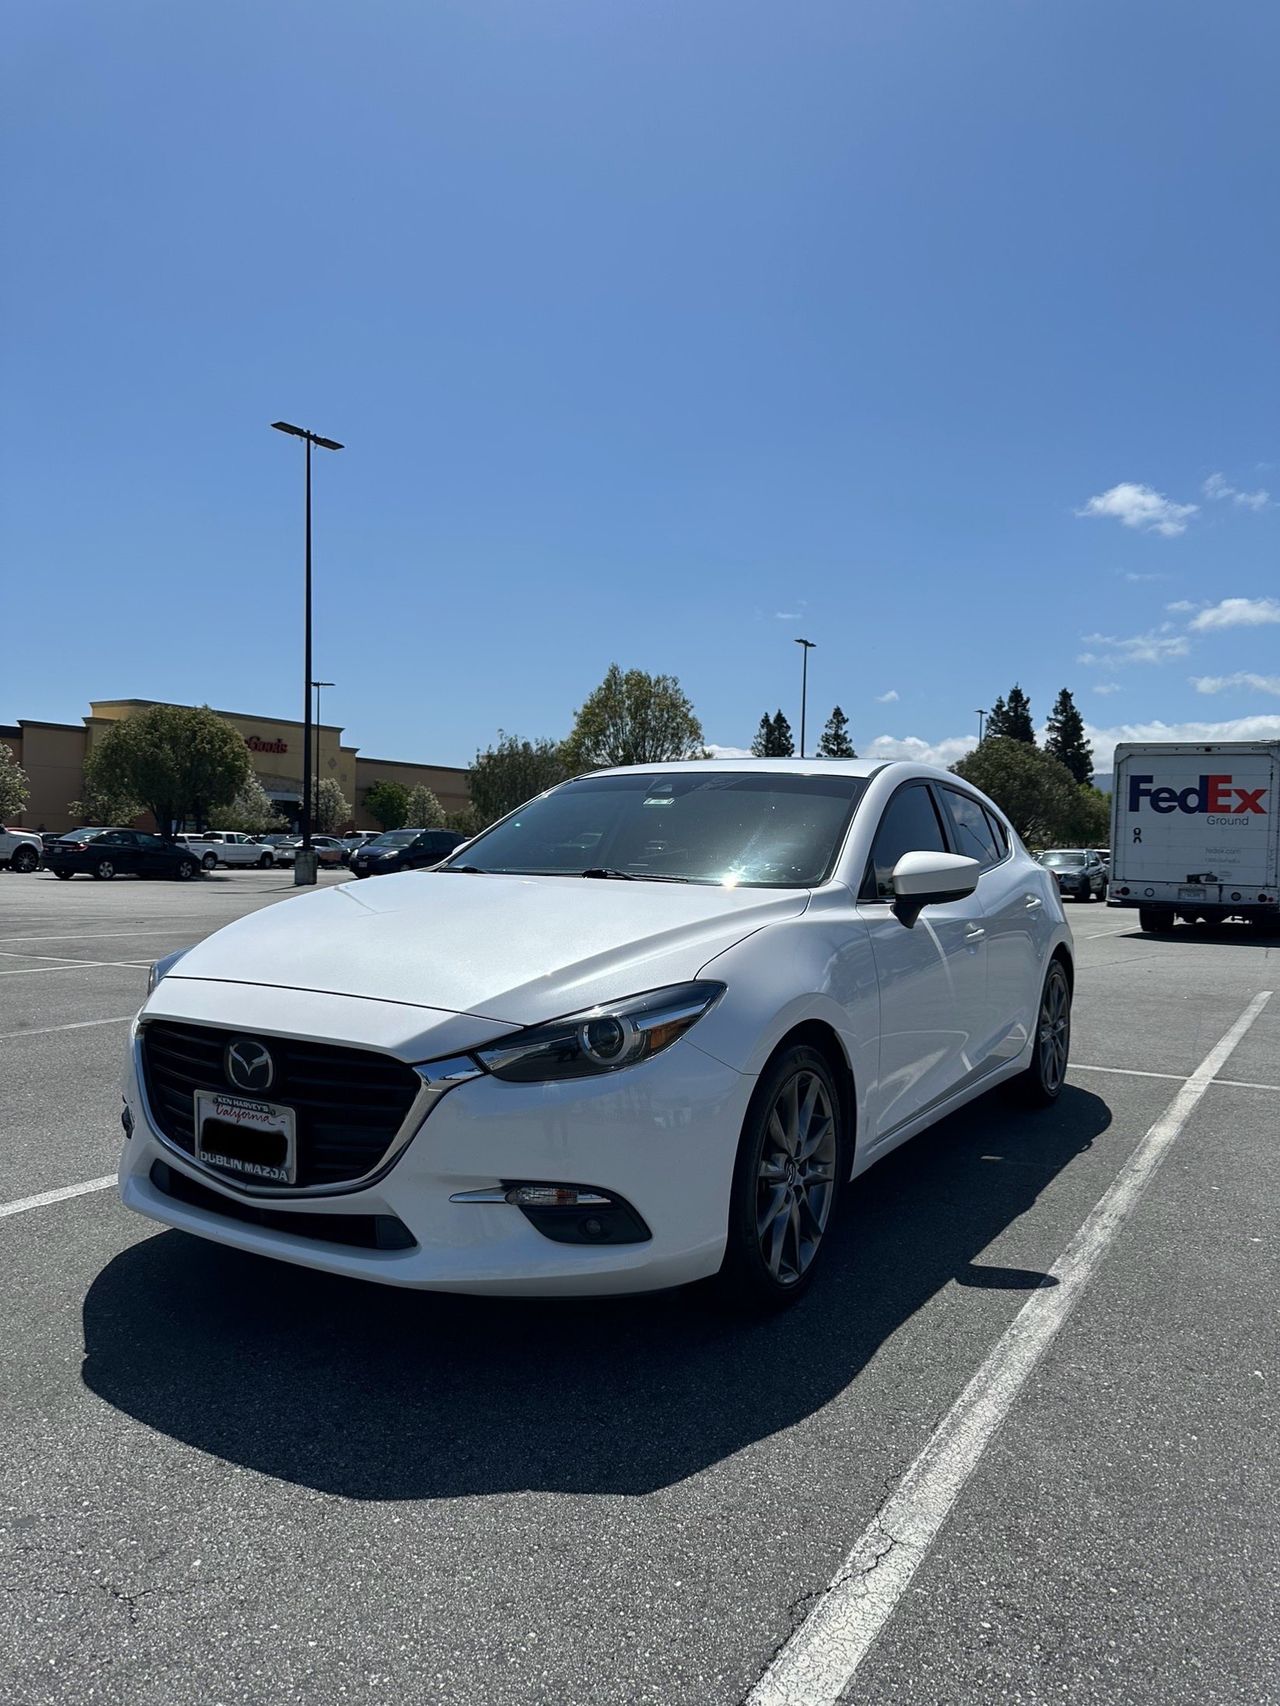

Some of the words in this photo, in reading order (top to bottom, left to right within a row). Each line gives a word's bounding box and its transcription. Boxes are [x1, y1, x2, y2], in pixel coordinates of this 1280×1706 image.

[1128, 775, 1268, 814] FedEx
[1206, 816, 1249, 826] Ground
[217, 1097, 233, 1105] KEN
[215, 1103, 273, 1123] California
[200, 1151, 242, 1170] DUBLIN
[244, 1163, 288, 1180] MAZDA
